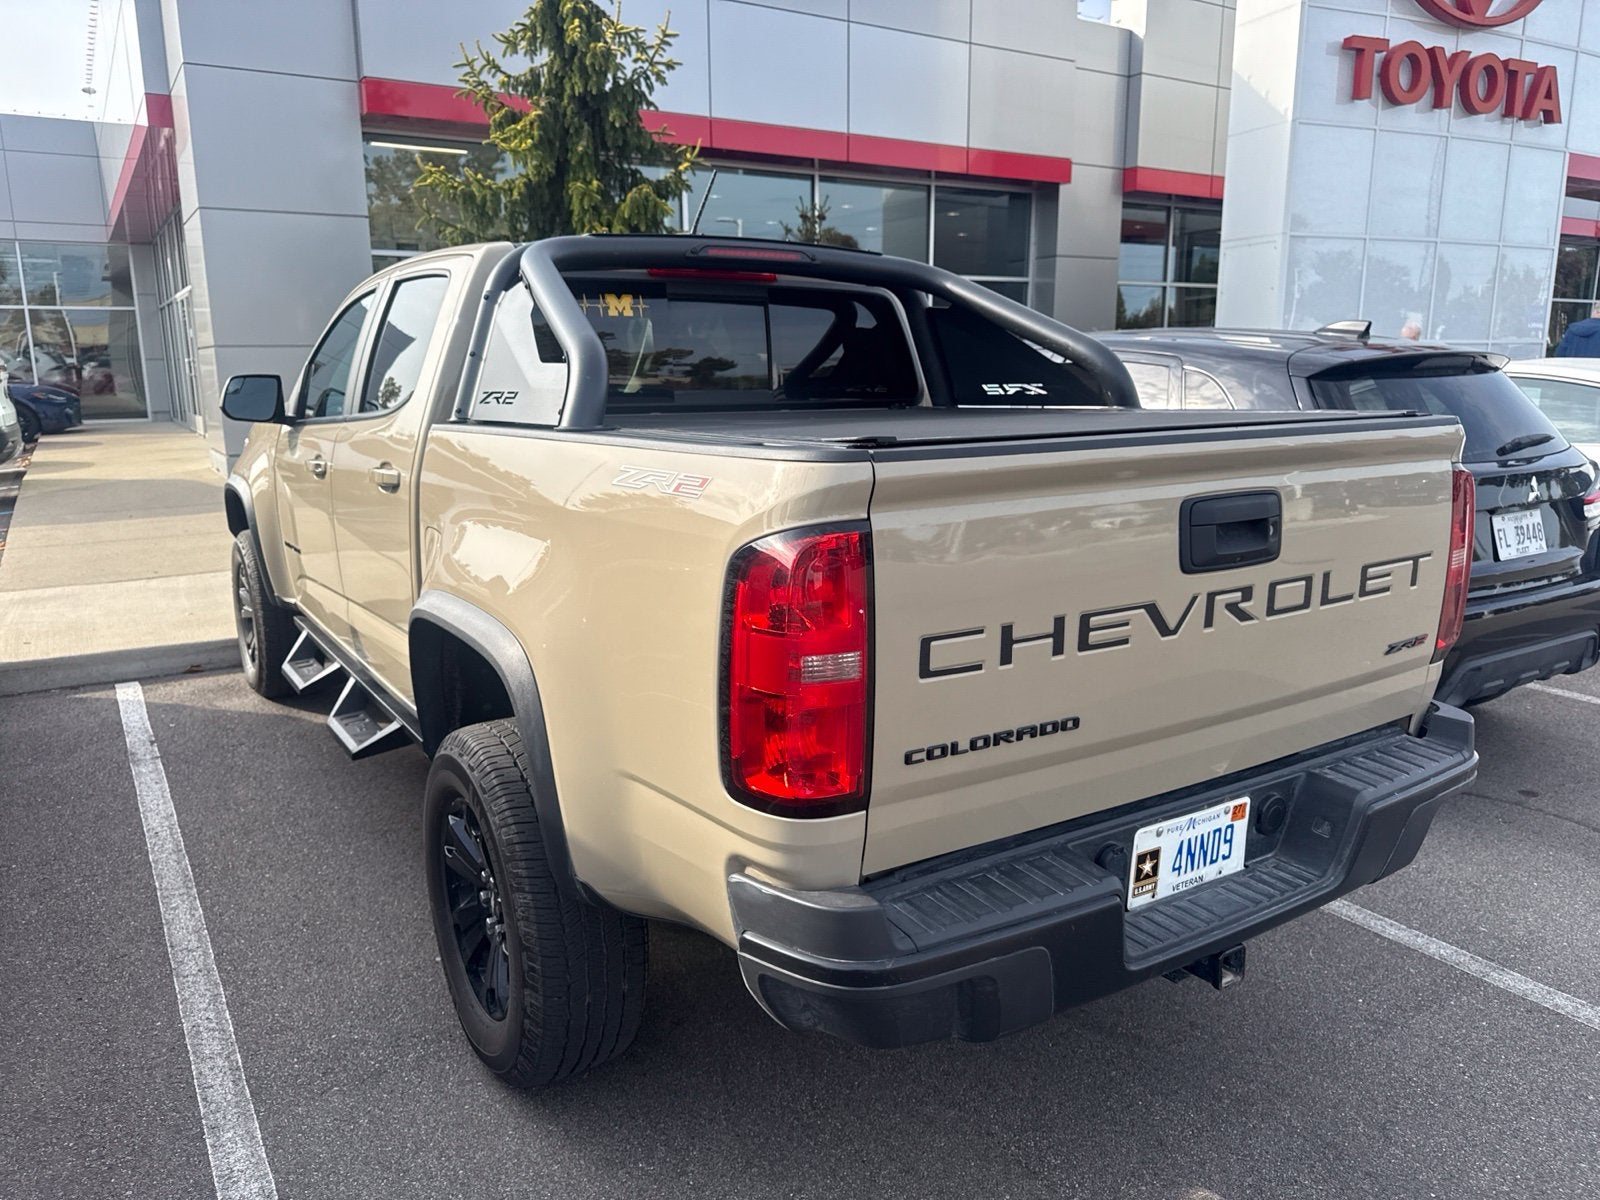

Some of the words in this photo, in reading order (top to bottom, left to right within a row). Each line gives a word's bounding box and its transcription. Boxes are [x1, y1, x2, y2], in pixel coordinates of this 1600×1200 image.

[1342, 34, 1562, 124] TOYOTA
[604, 293, 634, 317] M
[479, 391, 519, 405] ZR2
[611, 464, 714, 499] ZR2
[1497, 527, 1511, 550] FL
[1514, 521, 1543, 546] 39448
[918, 551, 1433, 682] CHEVROLET
[1384, 633, 1429, 656] ZR2
[903, 715, 1081, 766] COLORADO
[1166, 825, 1183, 835] PURE
[1172, 823, 1235, 877] 4NND9
[1172, 874, 1204, 892] VETERAN
